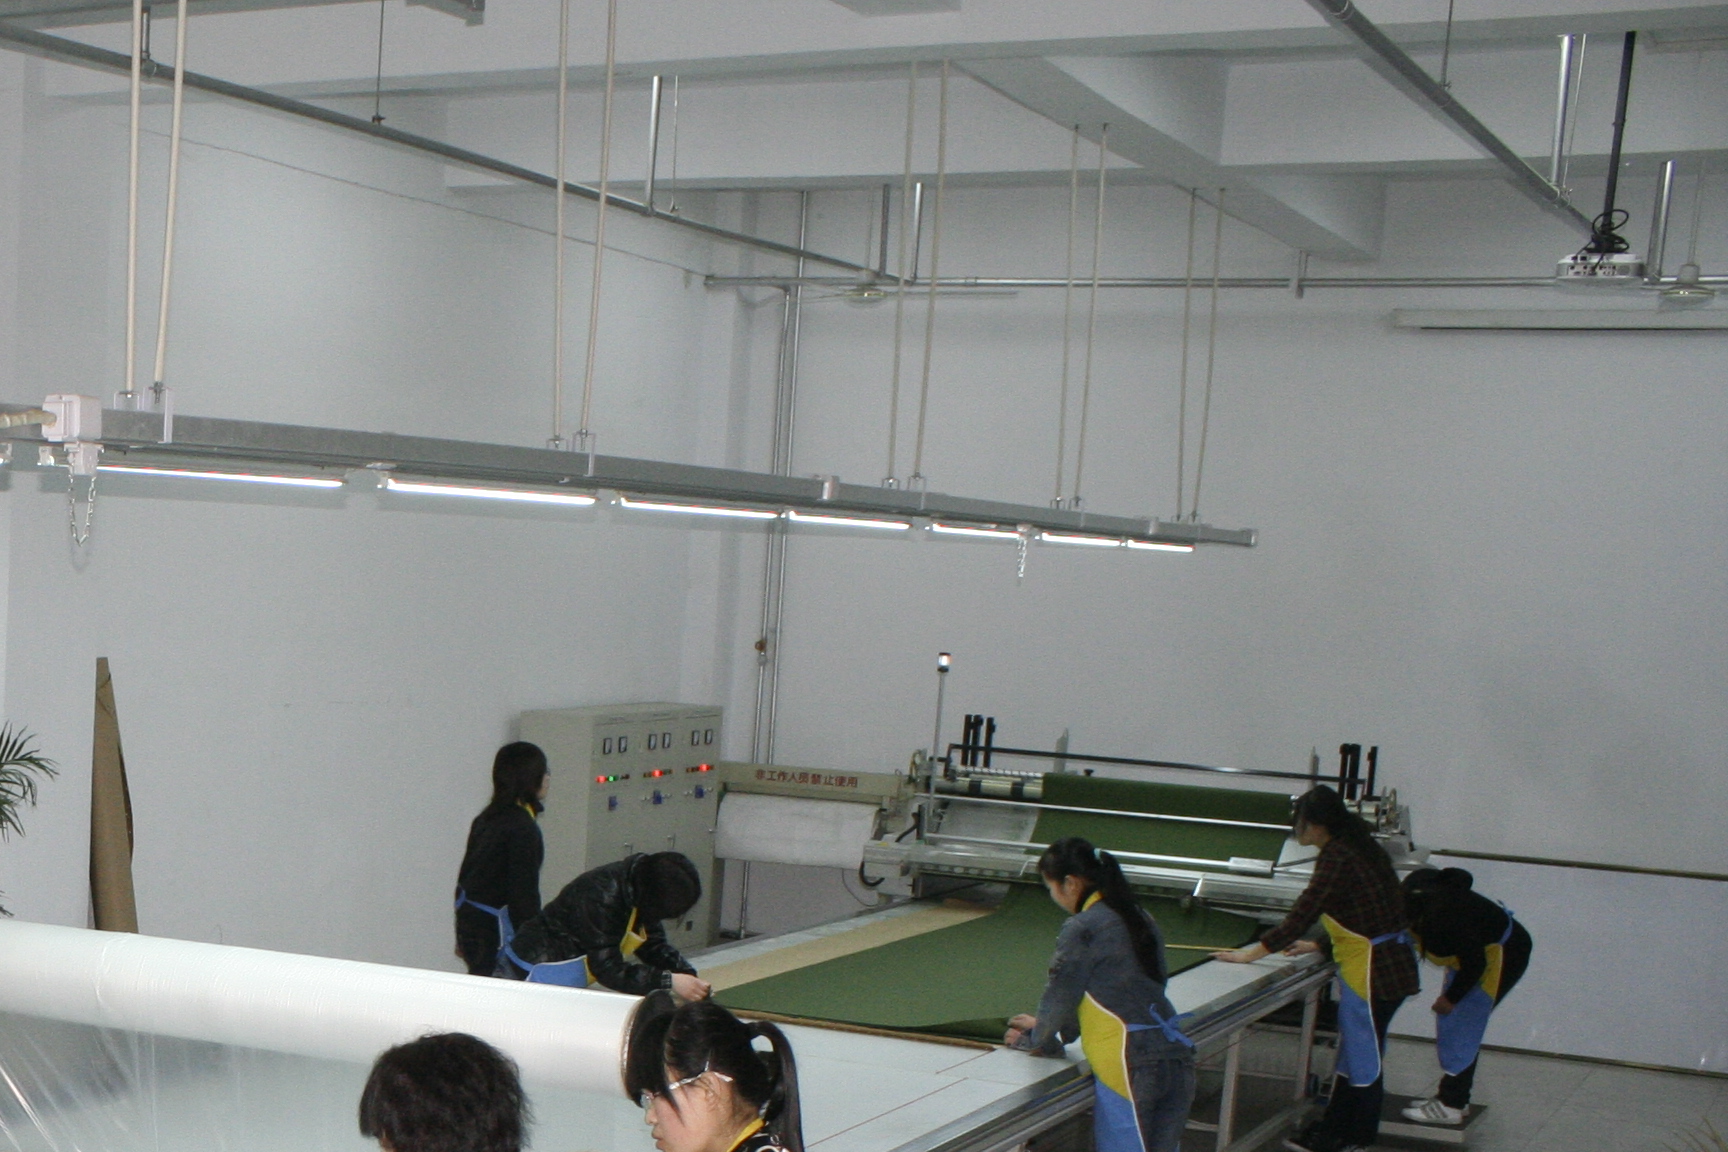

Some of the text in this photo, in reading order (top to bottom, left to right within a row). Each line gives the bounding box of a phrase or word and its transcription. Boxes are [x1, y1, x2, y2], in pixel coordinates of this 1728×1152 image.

[755, 768, 858, 788] 非工作人员禁止使用
